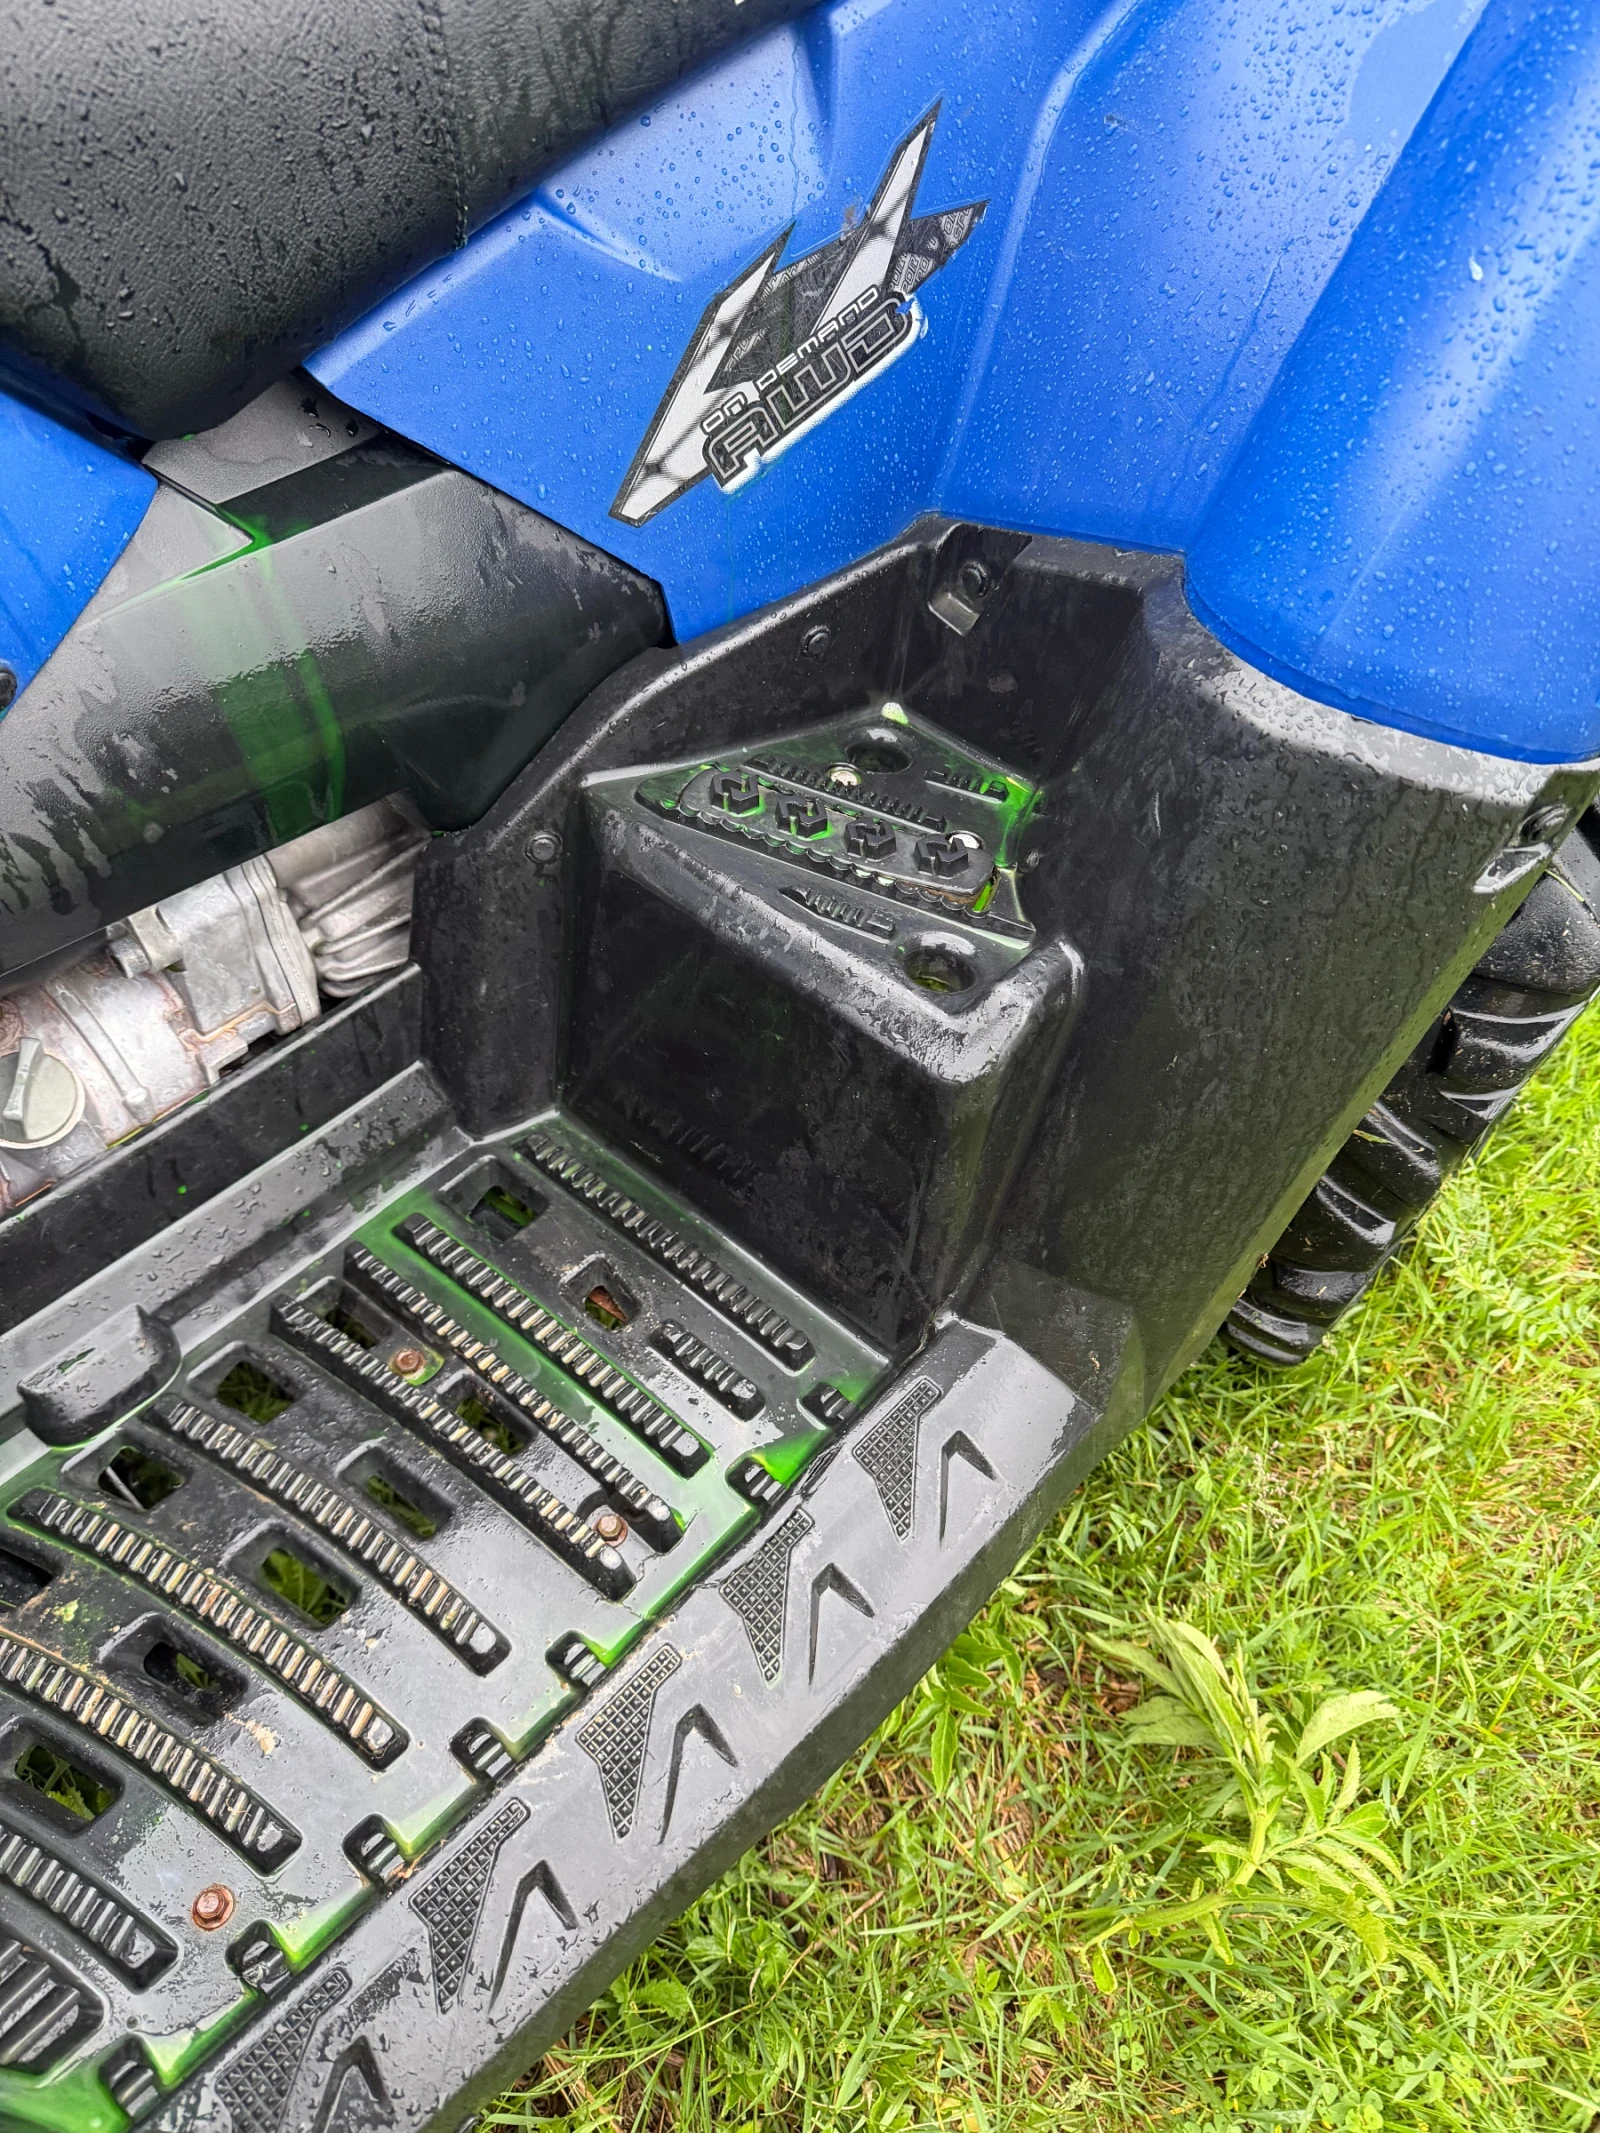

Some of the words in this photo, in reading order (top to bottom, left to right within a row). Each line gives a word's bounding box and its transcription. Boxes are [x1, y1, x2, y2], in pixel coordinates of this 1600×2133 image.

[703, 395, 745, 433] ON
[757, 287, 878, 389] DEMAND
[707, 297, 909, 480] AWD
